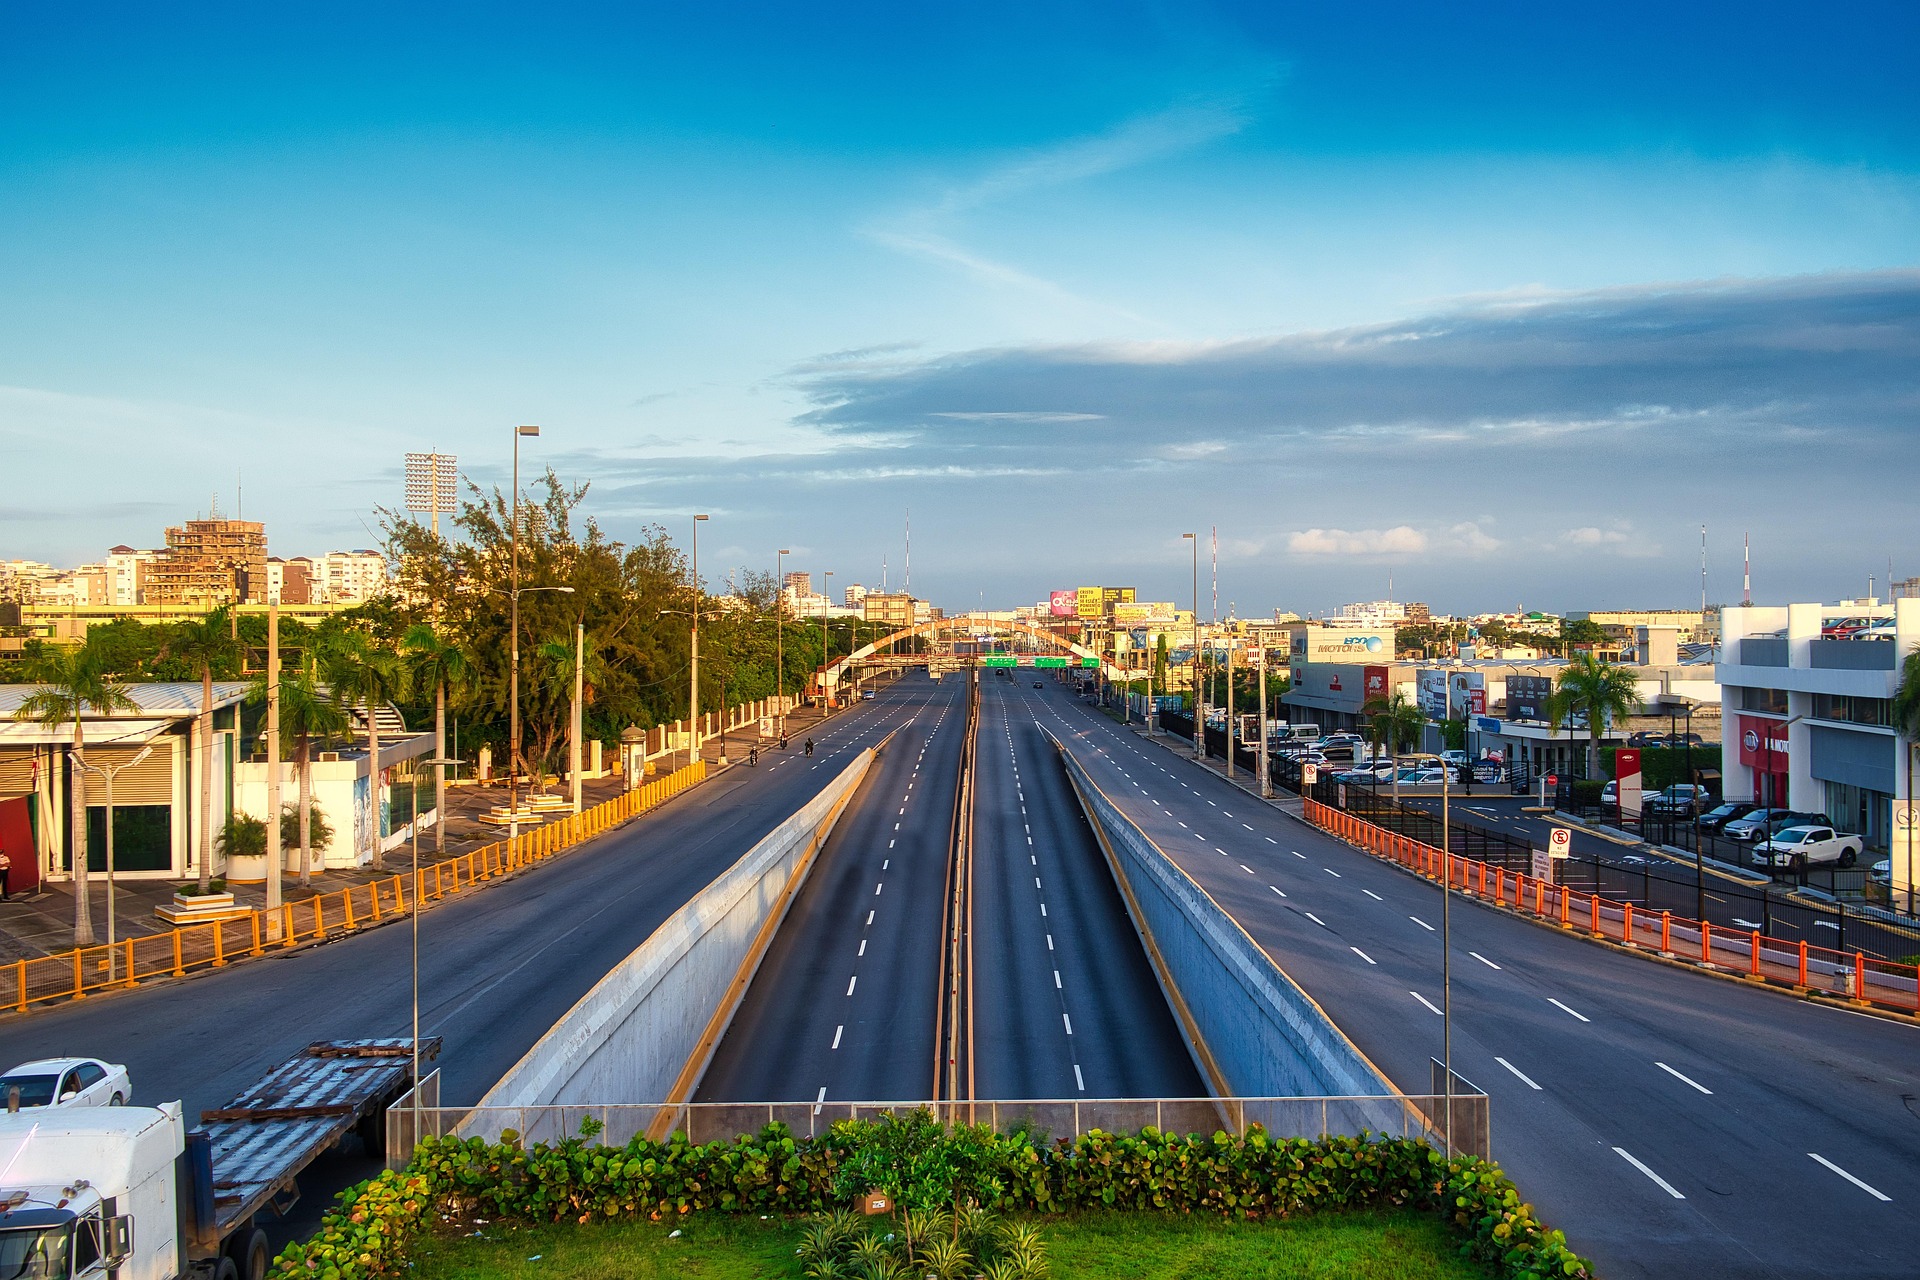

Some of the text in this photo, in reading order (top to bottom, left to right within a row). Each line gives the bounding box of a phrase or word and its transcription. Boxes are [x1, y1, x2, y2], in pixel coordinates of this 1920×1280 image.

[1369, 676, 1382, 688] JAC
[1765, 737, 1789, 753] KA MOTO
